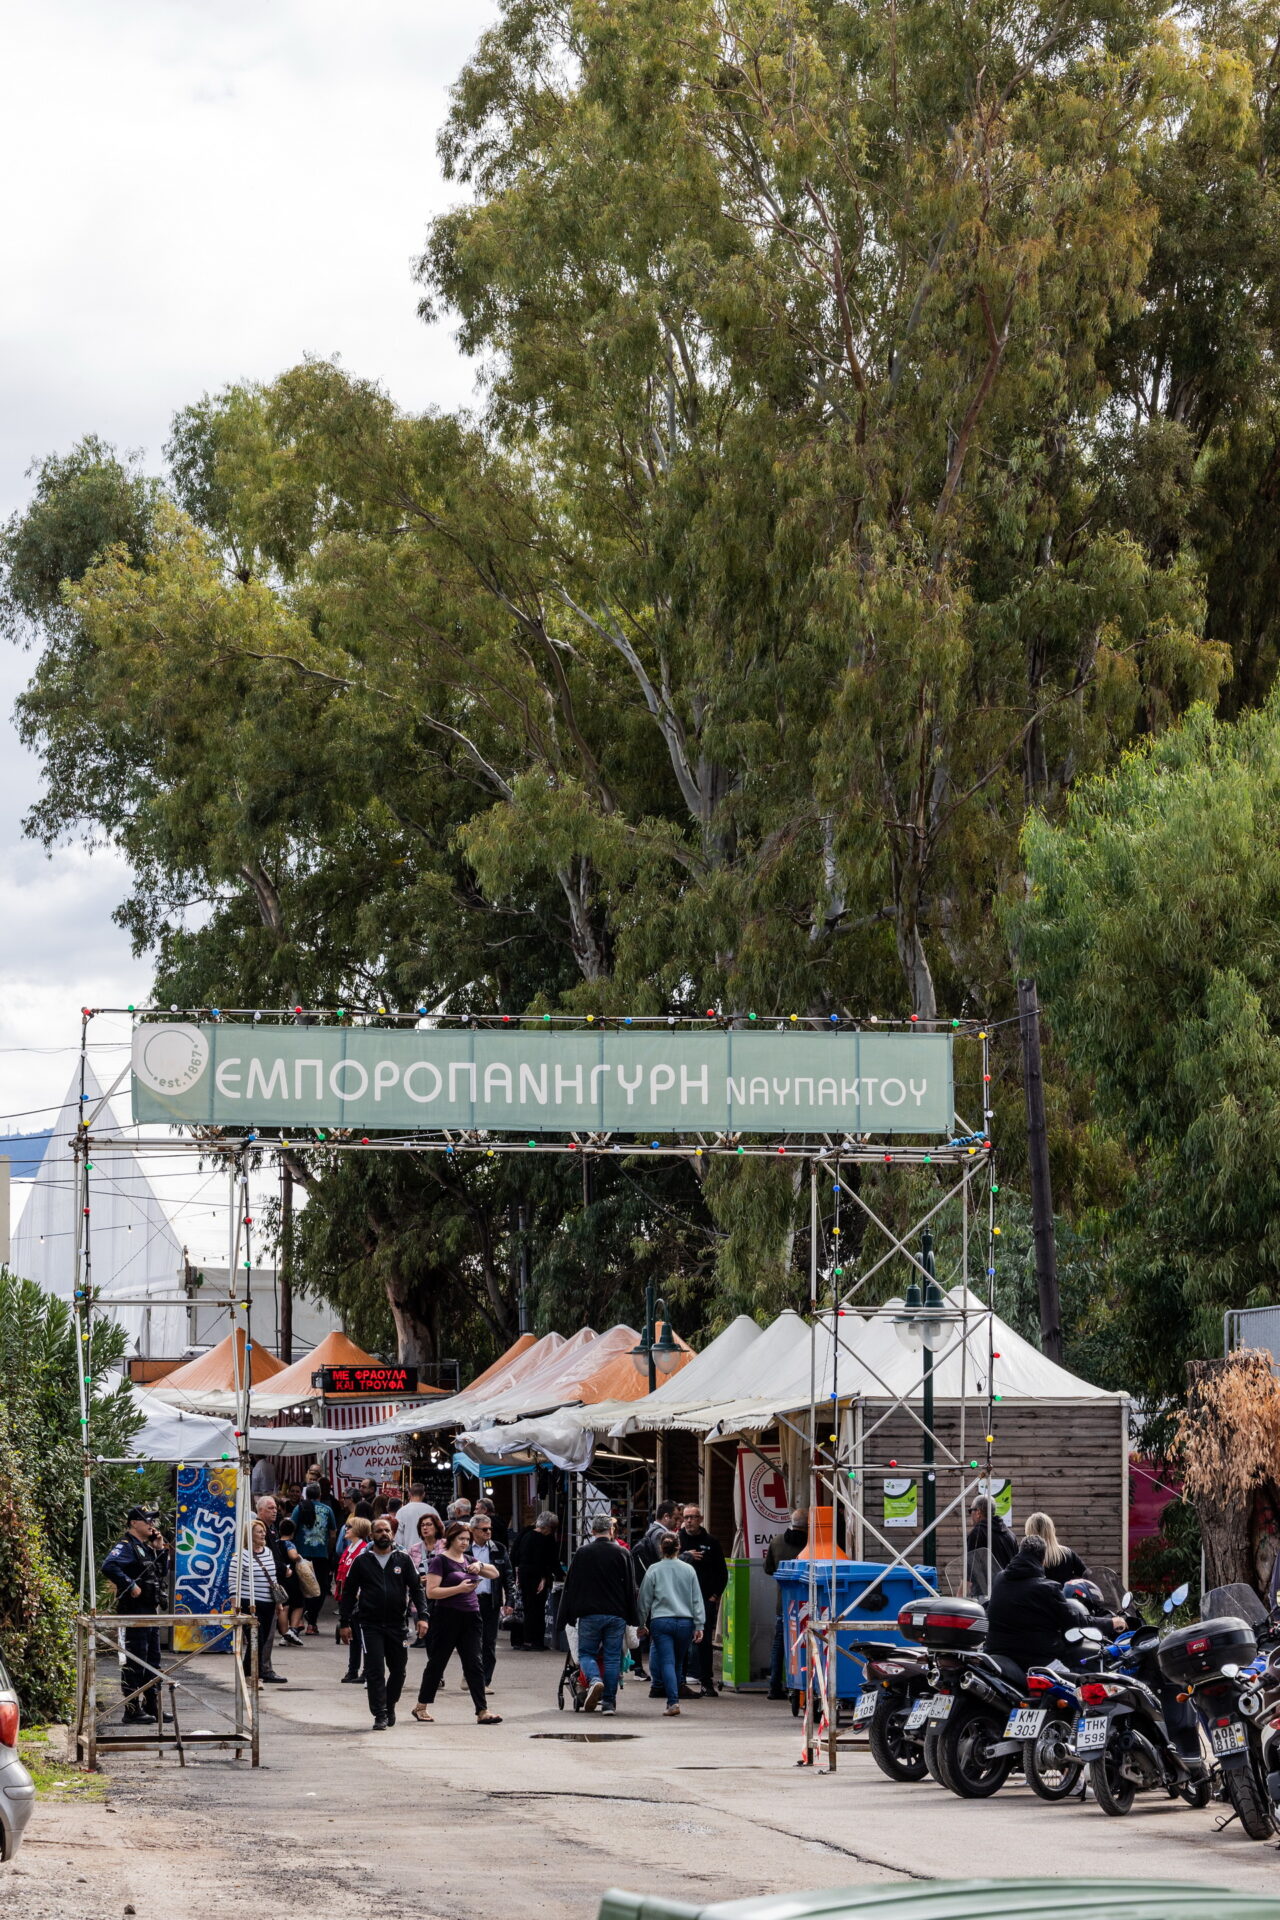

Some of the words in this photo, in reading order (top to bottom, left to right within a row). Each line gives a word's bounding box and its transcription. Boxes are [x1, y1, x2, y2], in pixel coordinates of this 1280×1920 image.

[215, 1057, 708, 1105] ΕΜΠΟΡΟΠΑΝΗΓΥΡΗ
[726, 1076, 927, 1107] ΝΑΥΠΑΚΤΟΥ
[332, 1370, 350, 1380] ΜΕ
[354, 1369, 407, 1380] ΦΡΑΟΥΛΑ
[336, 1381, 354, 1390] ΚΑΙ
[359, 1380, 404, 1390] ΤΡΟΥΦΑ
[350, 1445, 400, 1456] ΛΟΥΚΟΥΜ
[365, 1456, 403, 1467] ΑΡΚΑΔΙ
[1014, 1725, 1037, 1737] 303
[1084, 1732, 1105, 1744] 598
